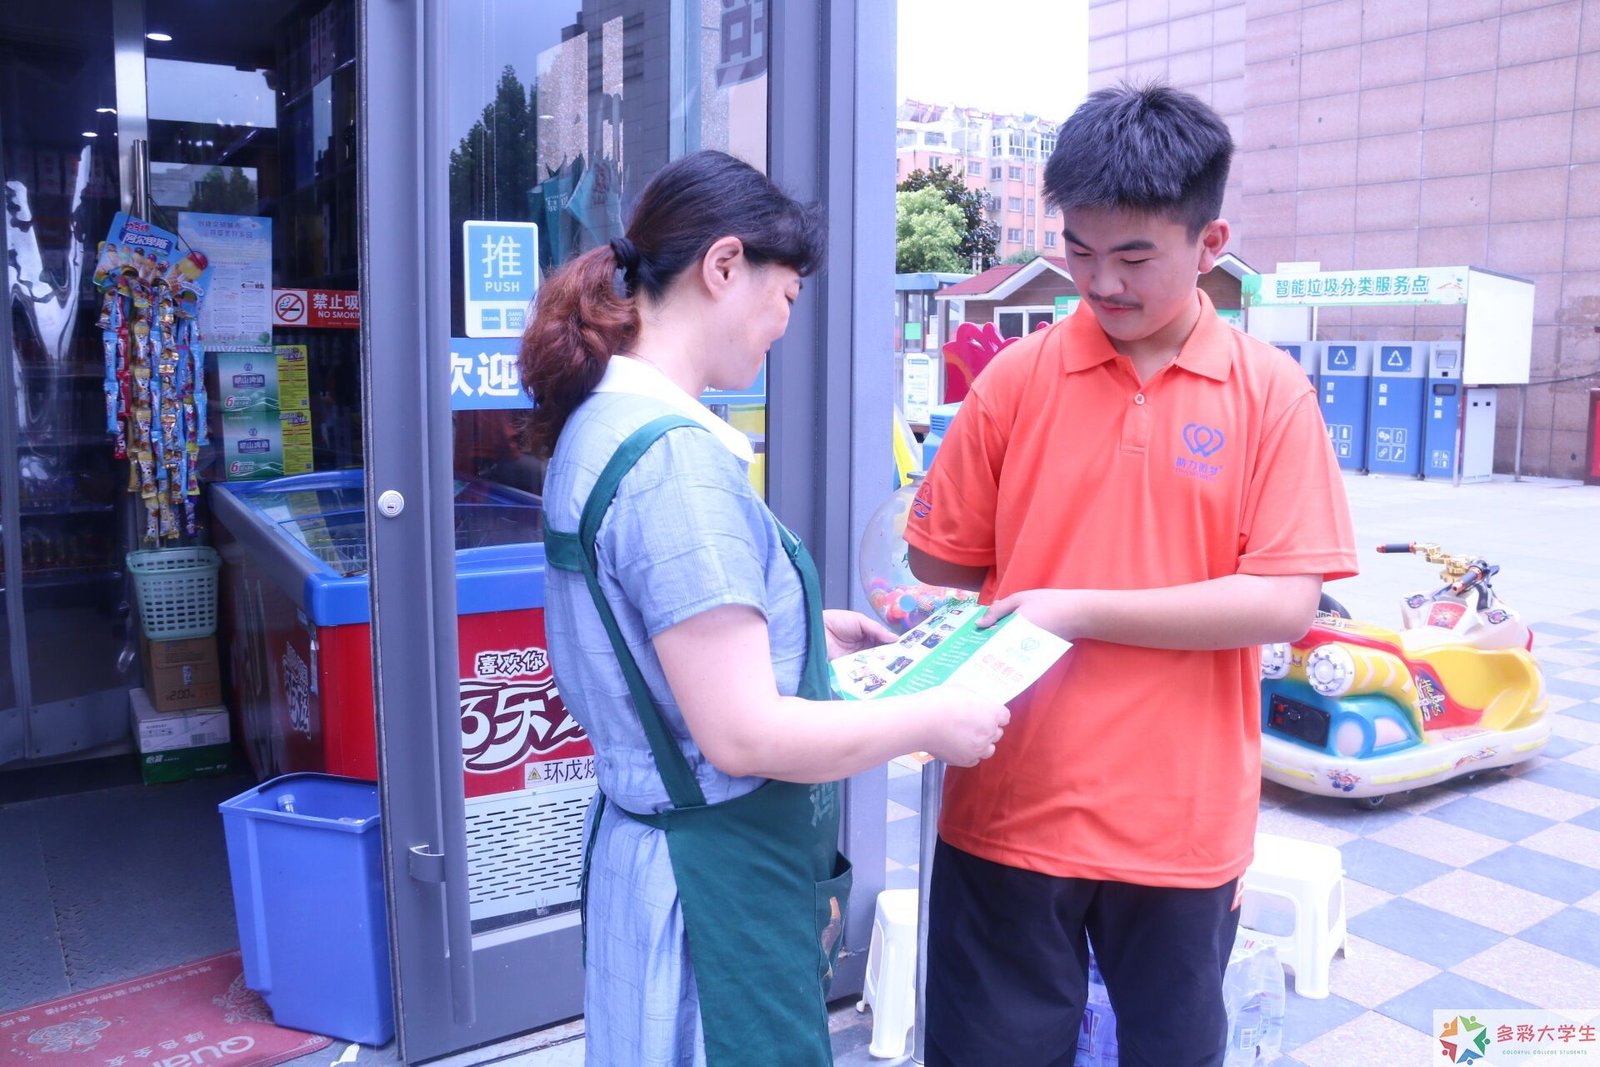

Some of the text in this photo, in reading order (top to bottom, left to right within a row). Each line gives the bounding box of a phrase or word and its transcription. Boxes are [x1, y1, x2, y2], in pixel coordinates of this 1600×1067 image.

[482, 235, 522, 278] 推
[485, 281, 520, 293] PUSH
[1275, 274, 1430, 298] 智能垃圾分类服务点
[317, 310, 331, 318] NO
[478, 652, 546, 674] 喜欢你
